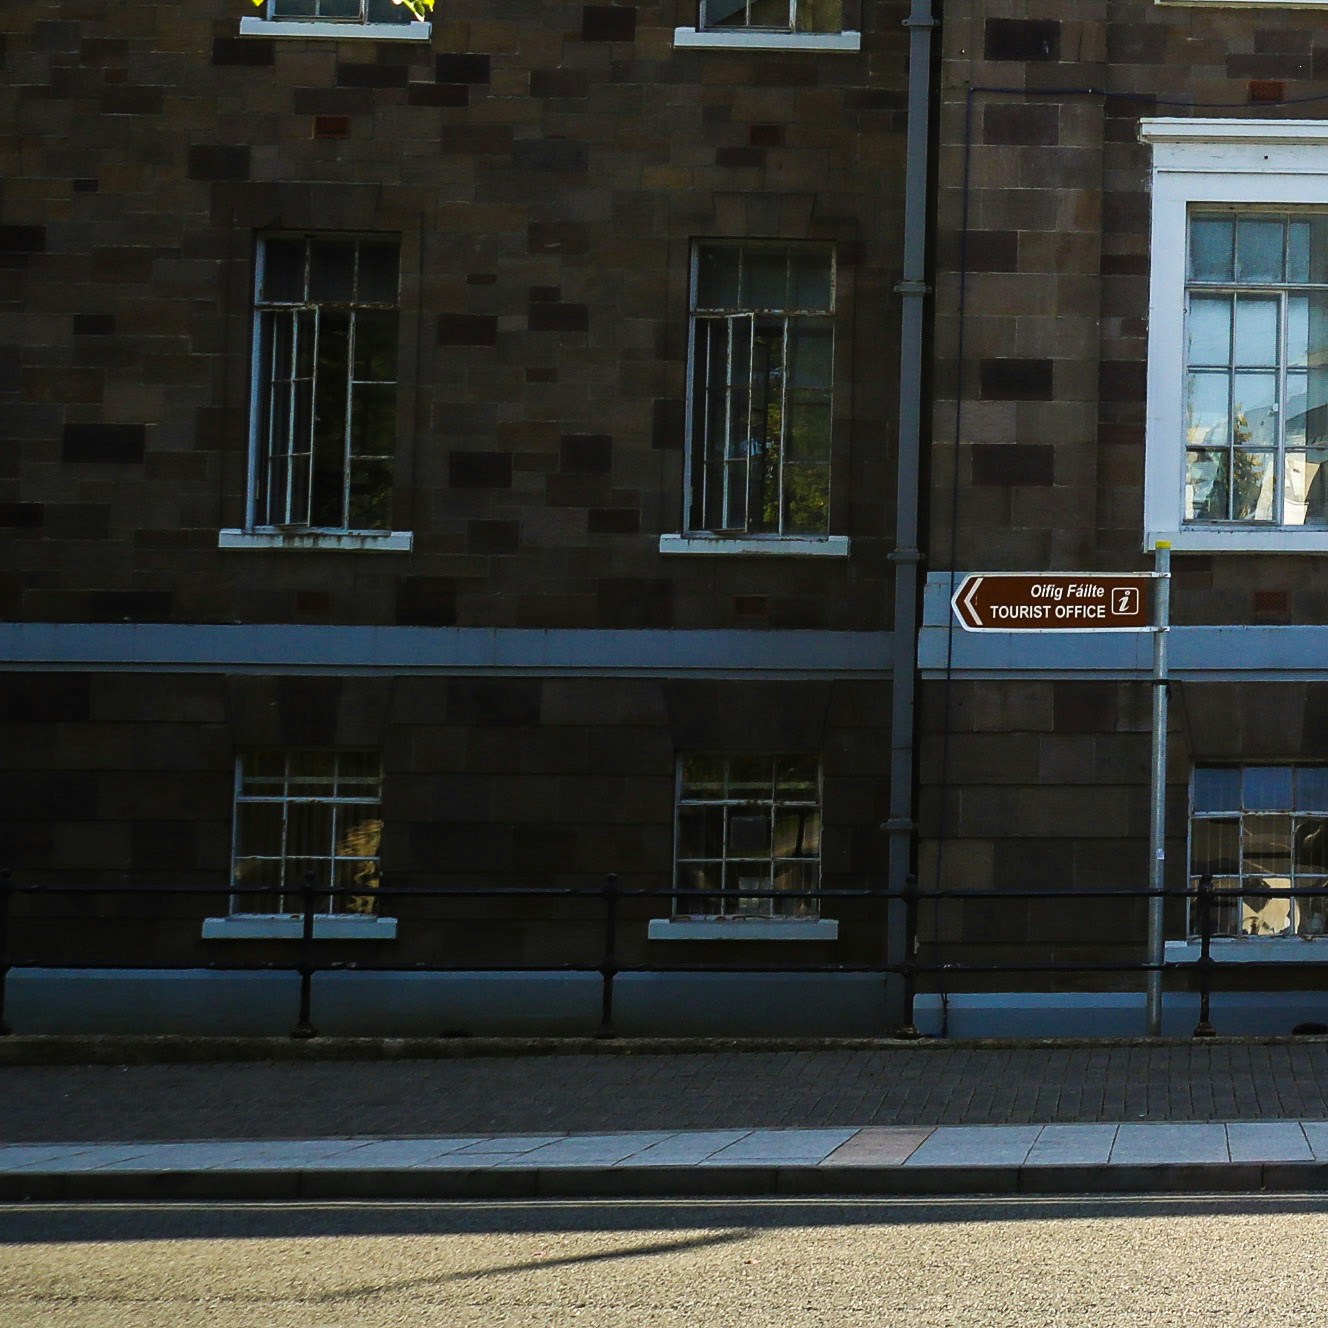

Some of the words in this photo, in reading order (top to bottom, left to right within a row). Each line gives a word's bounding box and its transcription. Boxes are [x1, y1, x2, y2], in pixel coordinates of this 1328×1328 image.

[1066, 583, 1105, 598] Fáilte
[990, 605, 1052, 619] TOURIST
[1055, 605, 1106, 618] OFFICE
